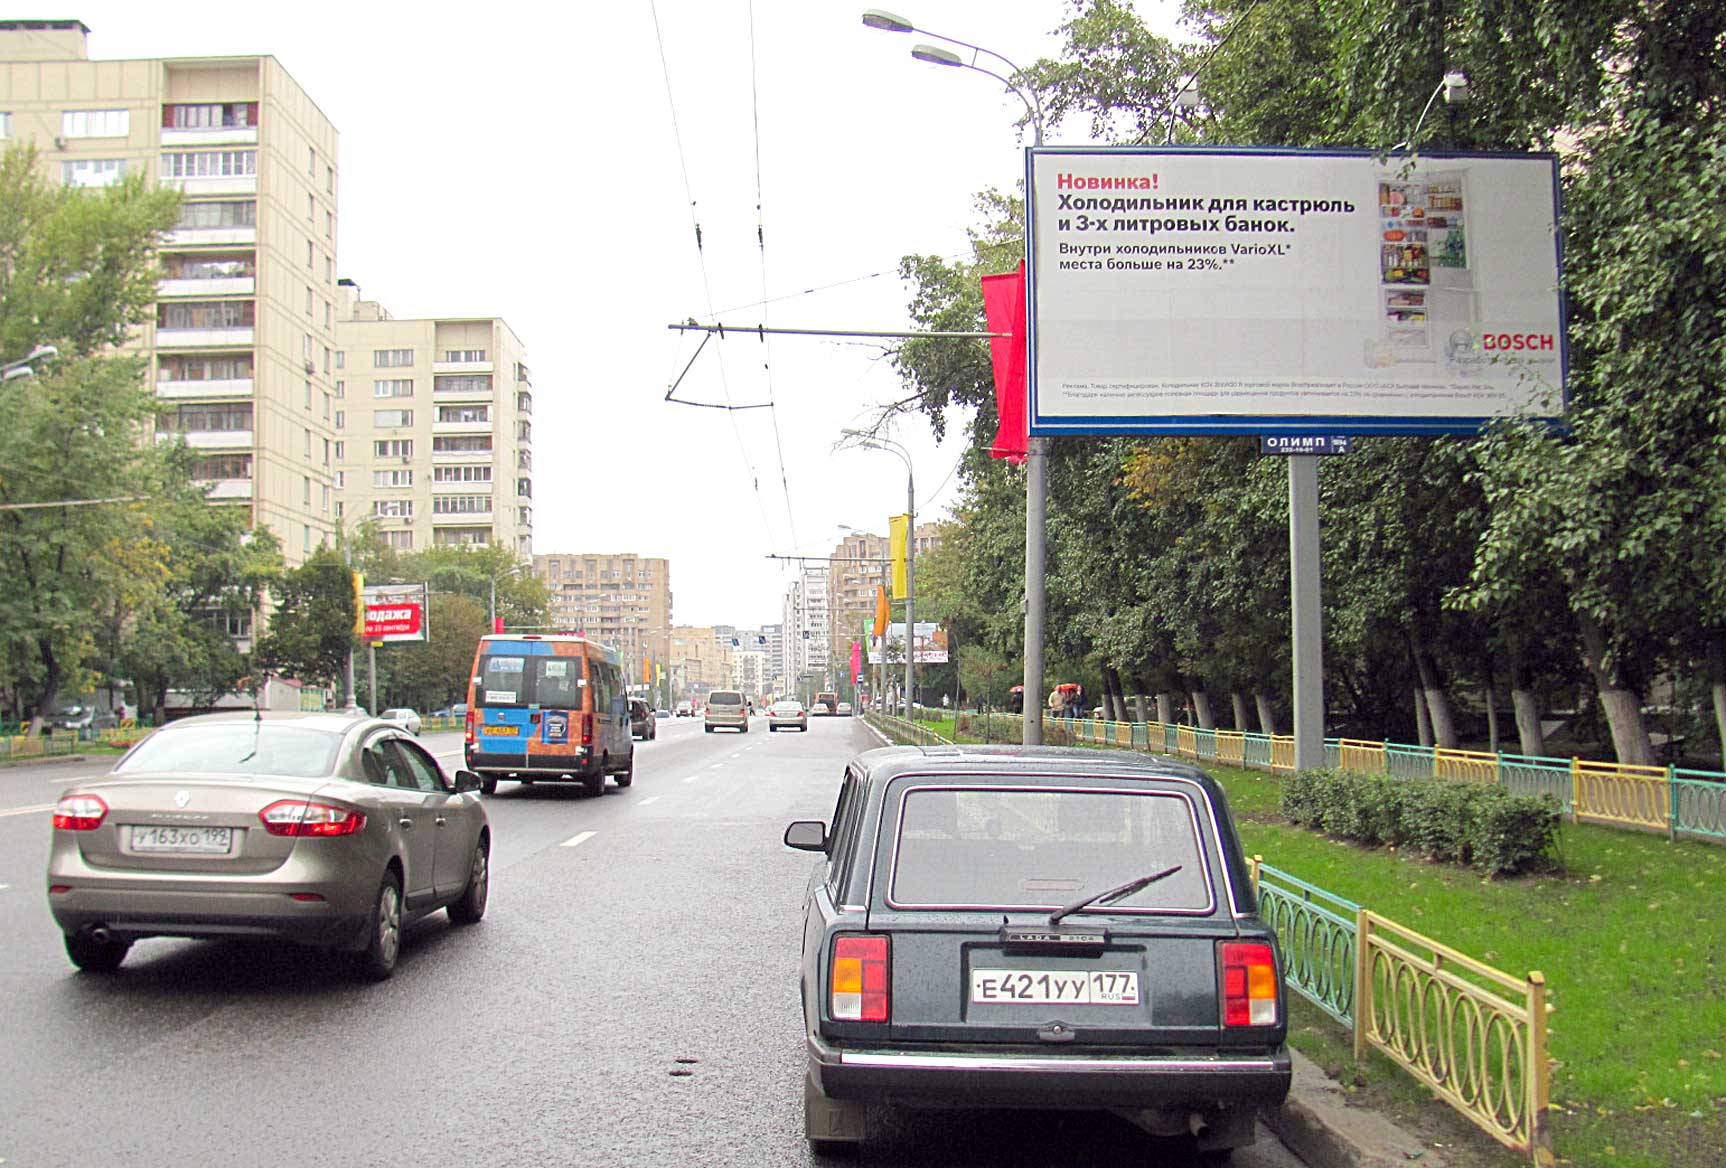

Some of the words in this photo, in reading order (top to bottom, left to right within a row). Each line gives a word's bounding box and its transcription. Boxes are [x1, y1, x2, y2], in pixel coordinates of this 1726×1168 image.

[1057, 173, 1159, 190] Новинка!
[1058, 194, 1204, 213] Холодильник
[1208, 198, 1248, 213] для
[1253, 199, 1356, 215] кастрюль
[1058, 219, 1071, 231] и
[1076, 215, 1108, 231] 3-х
[1113, 219, 1220, 234] литровых
[1225, 215, 1296, 232] банок.
[1059, 243, 1111, 257] Внутри
[1116, 244, 1227, 256] холодильников
[1059, 260, 1102, 270] места
[1106, 258, 1162, 270] больше
[1167, 260, 1184, 270] на
[1483, 333, 1554, 350] BOSCH
[1267, 437, 1325, 447] ОЛИМП
[1092, 974, 1131, 993] 177
[1101, 992, 1121, 1000] RUS
